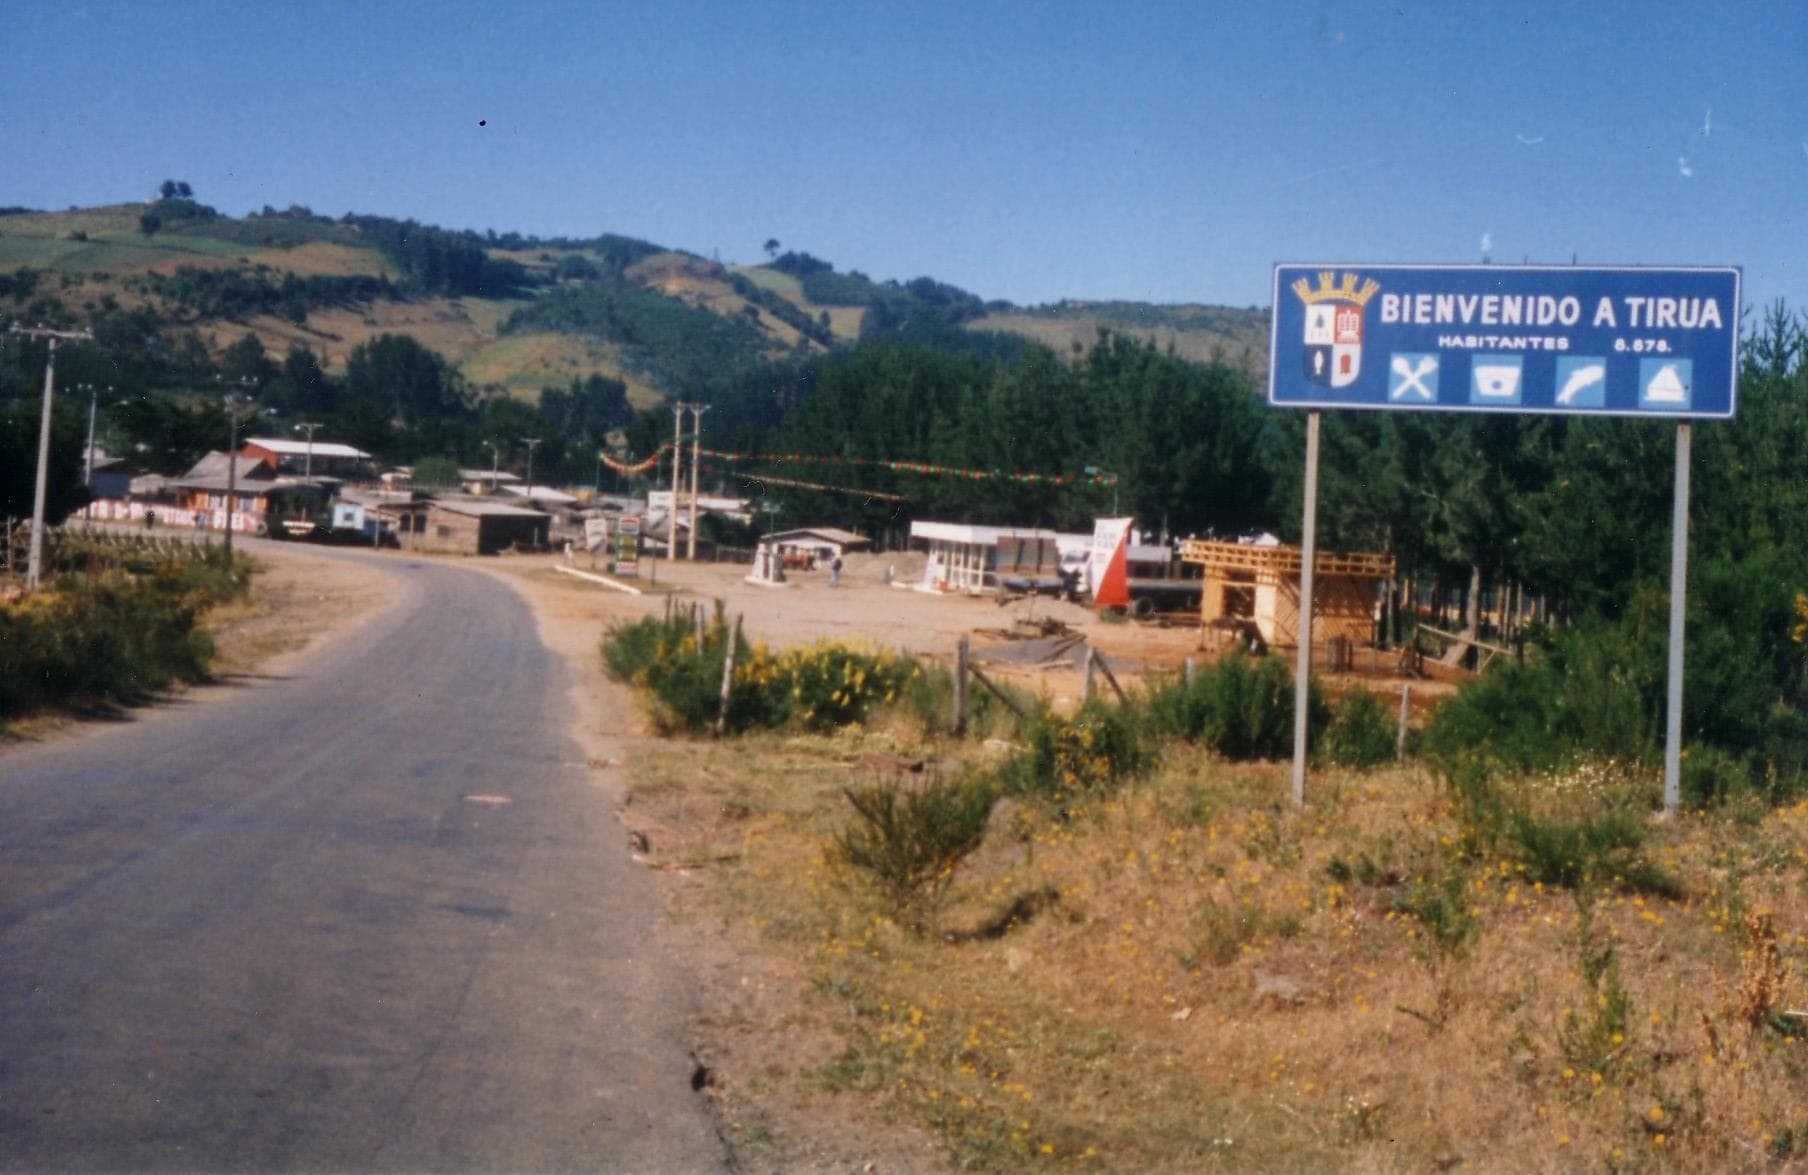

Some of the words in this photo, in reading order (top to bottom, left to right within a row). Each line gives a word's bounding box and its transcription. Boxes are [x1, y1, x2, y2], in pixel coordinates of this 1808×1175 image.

[1381, 294, 1580, 326] BIENVENIDO
[1592, 296, 1616, 328] A
[1624, 297, 1722, 329] TIRUA
[1438, 335, 1569, 350] HABITANTES
